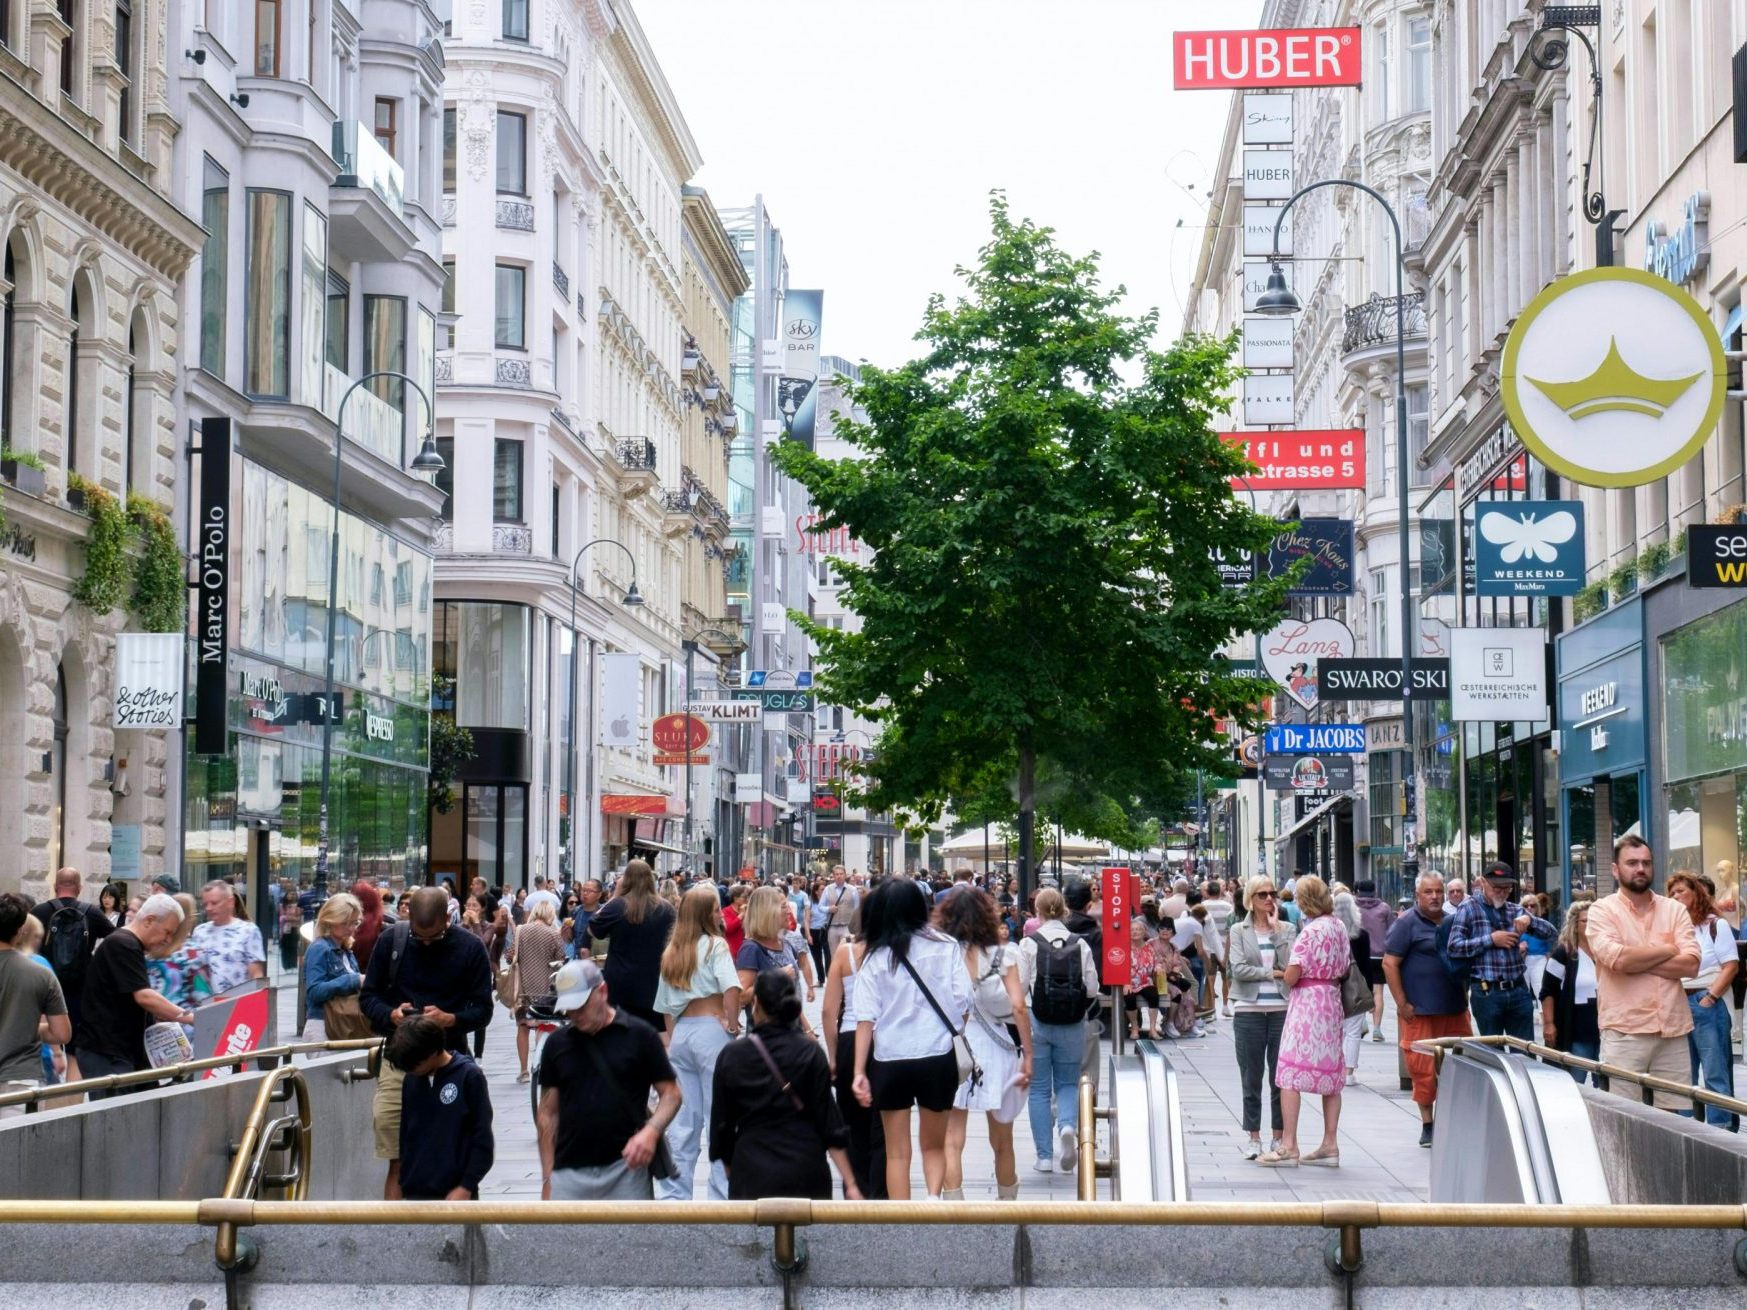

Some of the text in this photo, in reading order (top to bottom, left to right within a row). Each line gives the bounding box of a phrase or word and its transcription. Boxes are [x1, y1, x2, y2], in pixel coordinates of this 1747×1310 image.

[1247, 169, 1290, 180] HUBER
[1248, 225, 1289, 233] HANO
[789, 319, 817, 336] sky
[787, 343, 815, 351] BAR
[1300, 441, 1353, 457] und
[1341, 462, 1355, 477] 5
[1277, 531, 1313, 552] Chez
[1494, 570, 1565, 578] WEEKEND
[1514, 583, 1546, 591] MaxMara
[202, 595, 222, 664] Marc
[1269, 624, 1344, 658] Lanz
[1327, 670, 1447, 689] SWAROSKI
[117, 686, 178, 708] & other
[118, 704, 174, 725] Stories
[712, 705, 760, 718] KLIMT
[1284, 728, 1364, 749] Dr JACOBS
[1112, 873, 1121, 917] STOP
